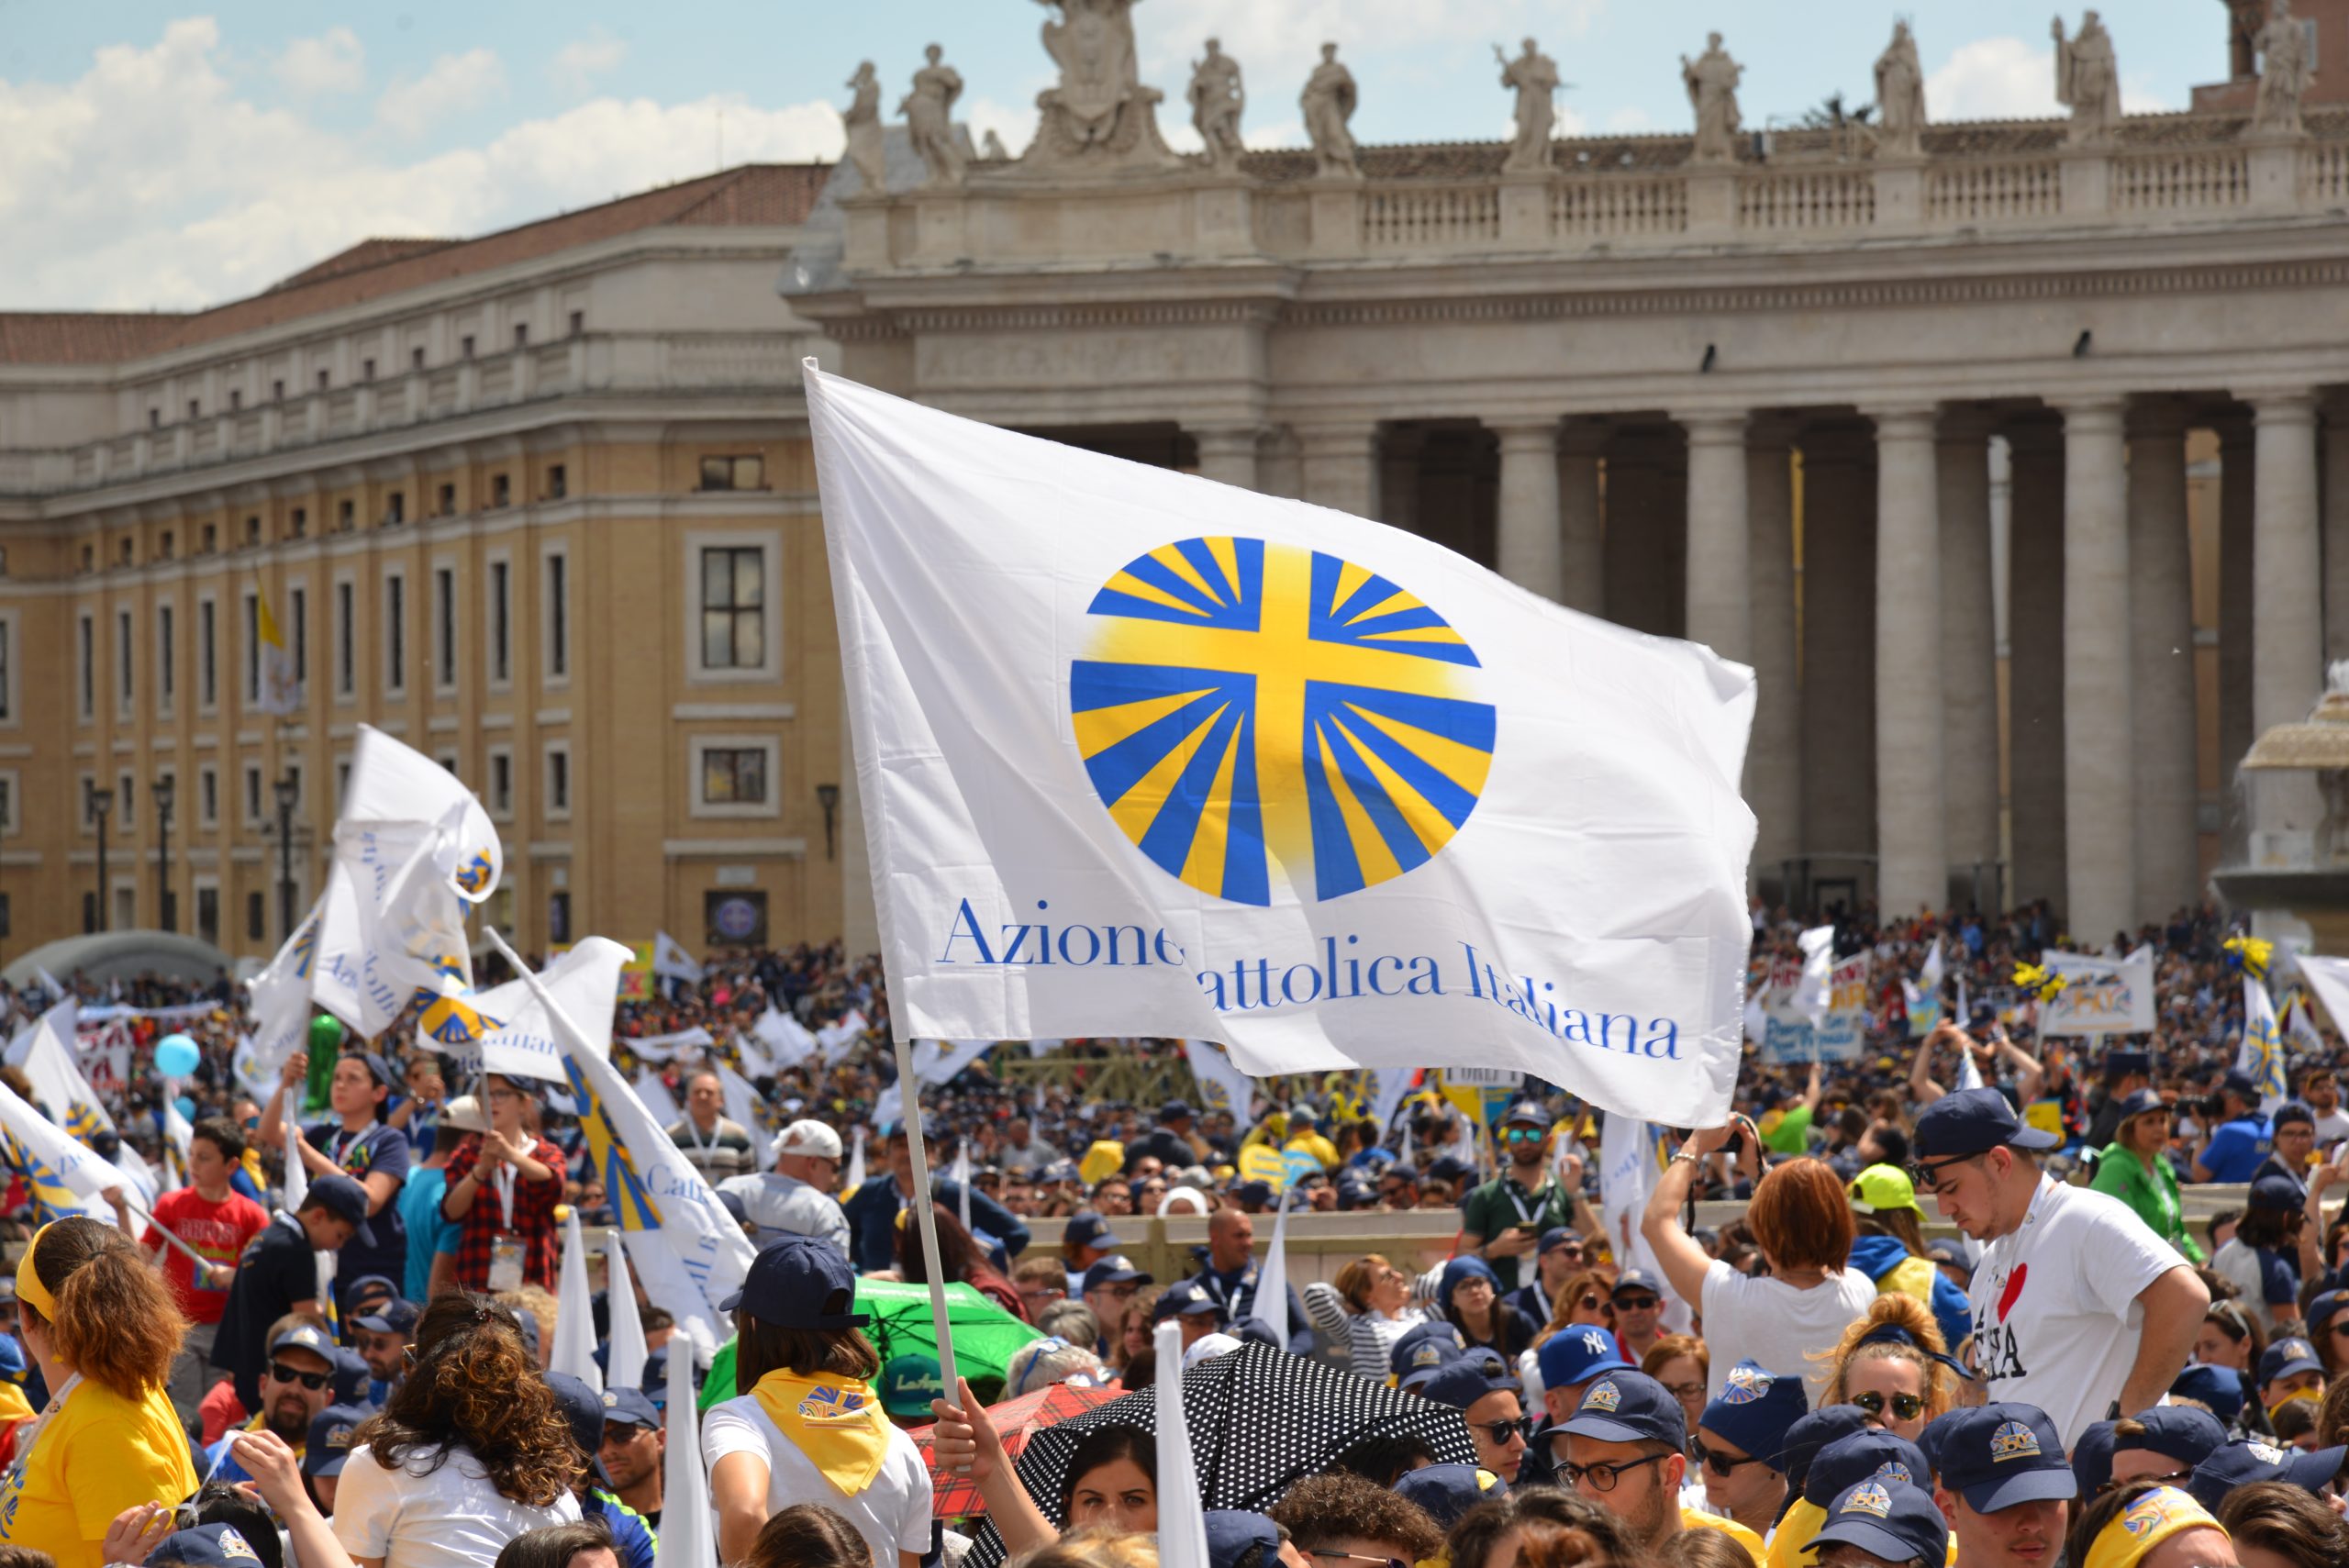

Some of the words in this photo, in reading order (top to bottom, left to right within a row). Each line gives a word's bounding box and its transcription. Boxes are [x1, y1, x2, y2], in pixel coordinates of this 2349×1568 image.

[1197, 934, 1448, 1011] attolica
[1457, 940, 1683, 1060] Italiana
[1582, 1331, 1608, 1355] NY
